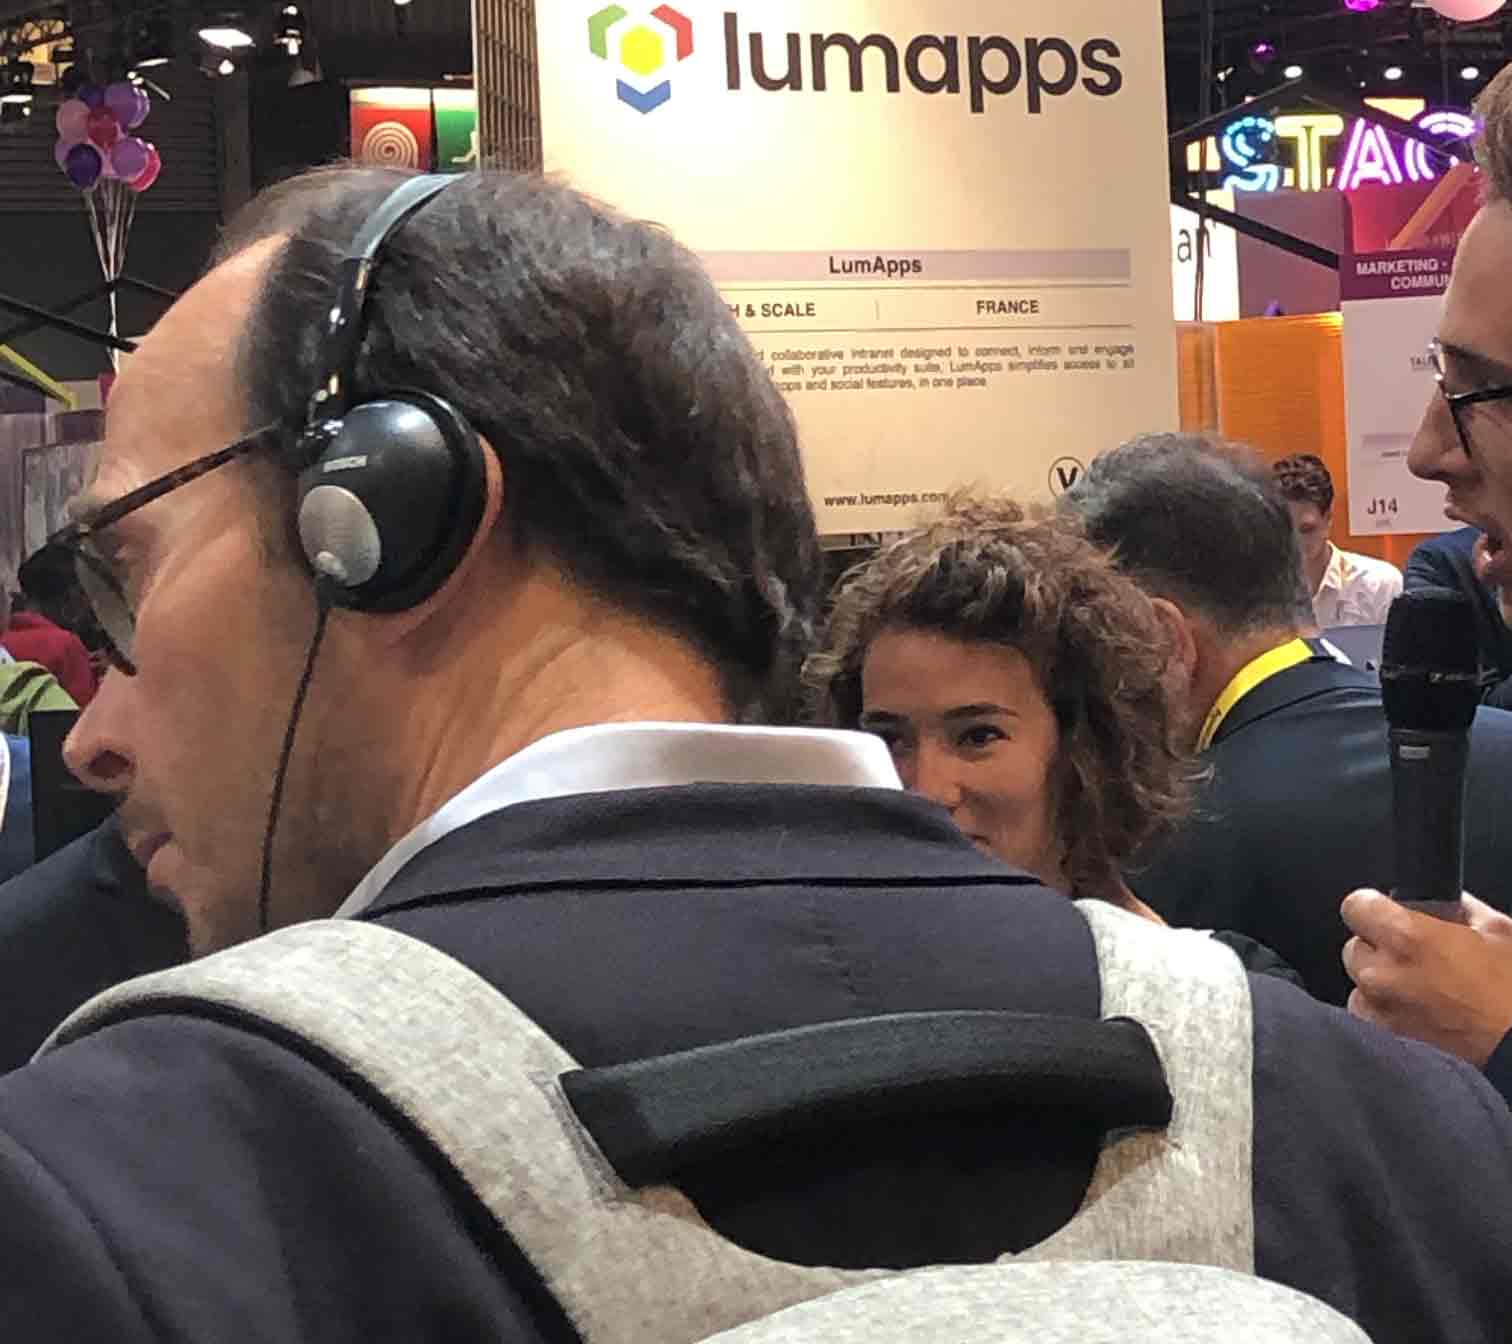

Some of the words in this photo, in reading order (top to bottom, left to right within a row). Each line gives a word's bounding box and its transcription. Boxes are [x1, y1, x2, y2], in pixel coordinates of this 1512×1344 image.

[723, 11, 1123, 114] lumapps
[829, 255, 923, 278] LumApps
[1356, 257, 1438, 276] MARKETING
[745, 303, 756, 318] &
[760, 302, 817, 318] SCALE
[976, 299, 1040, 315] FRANCE
[1367, 497, 1398, 515] J14
